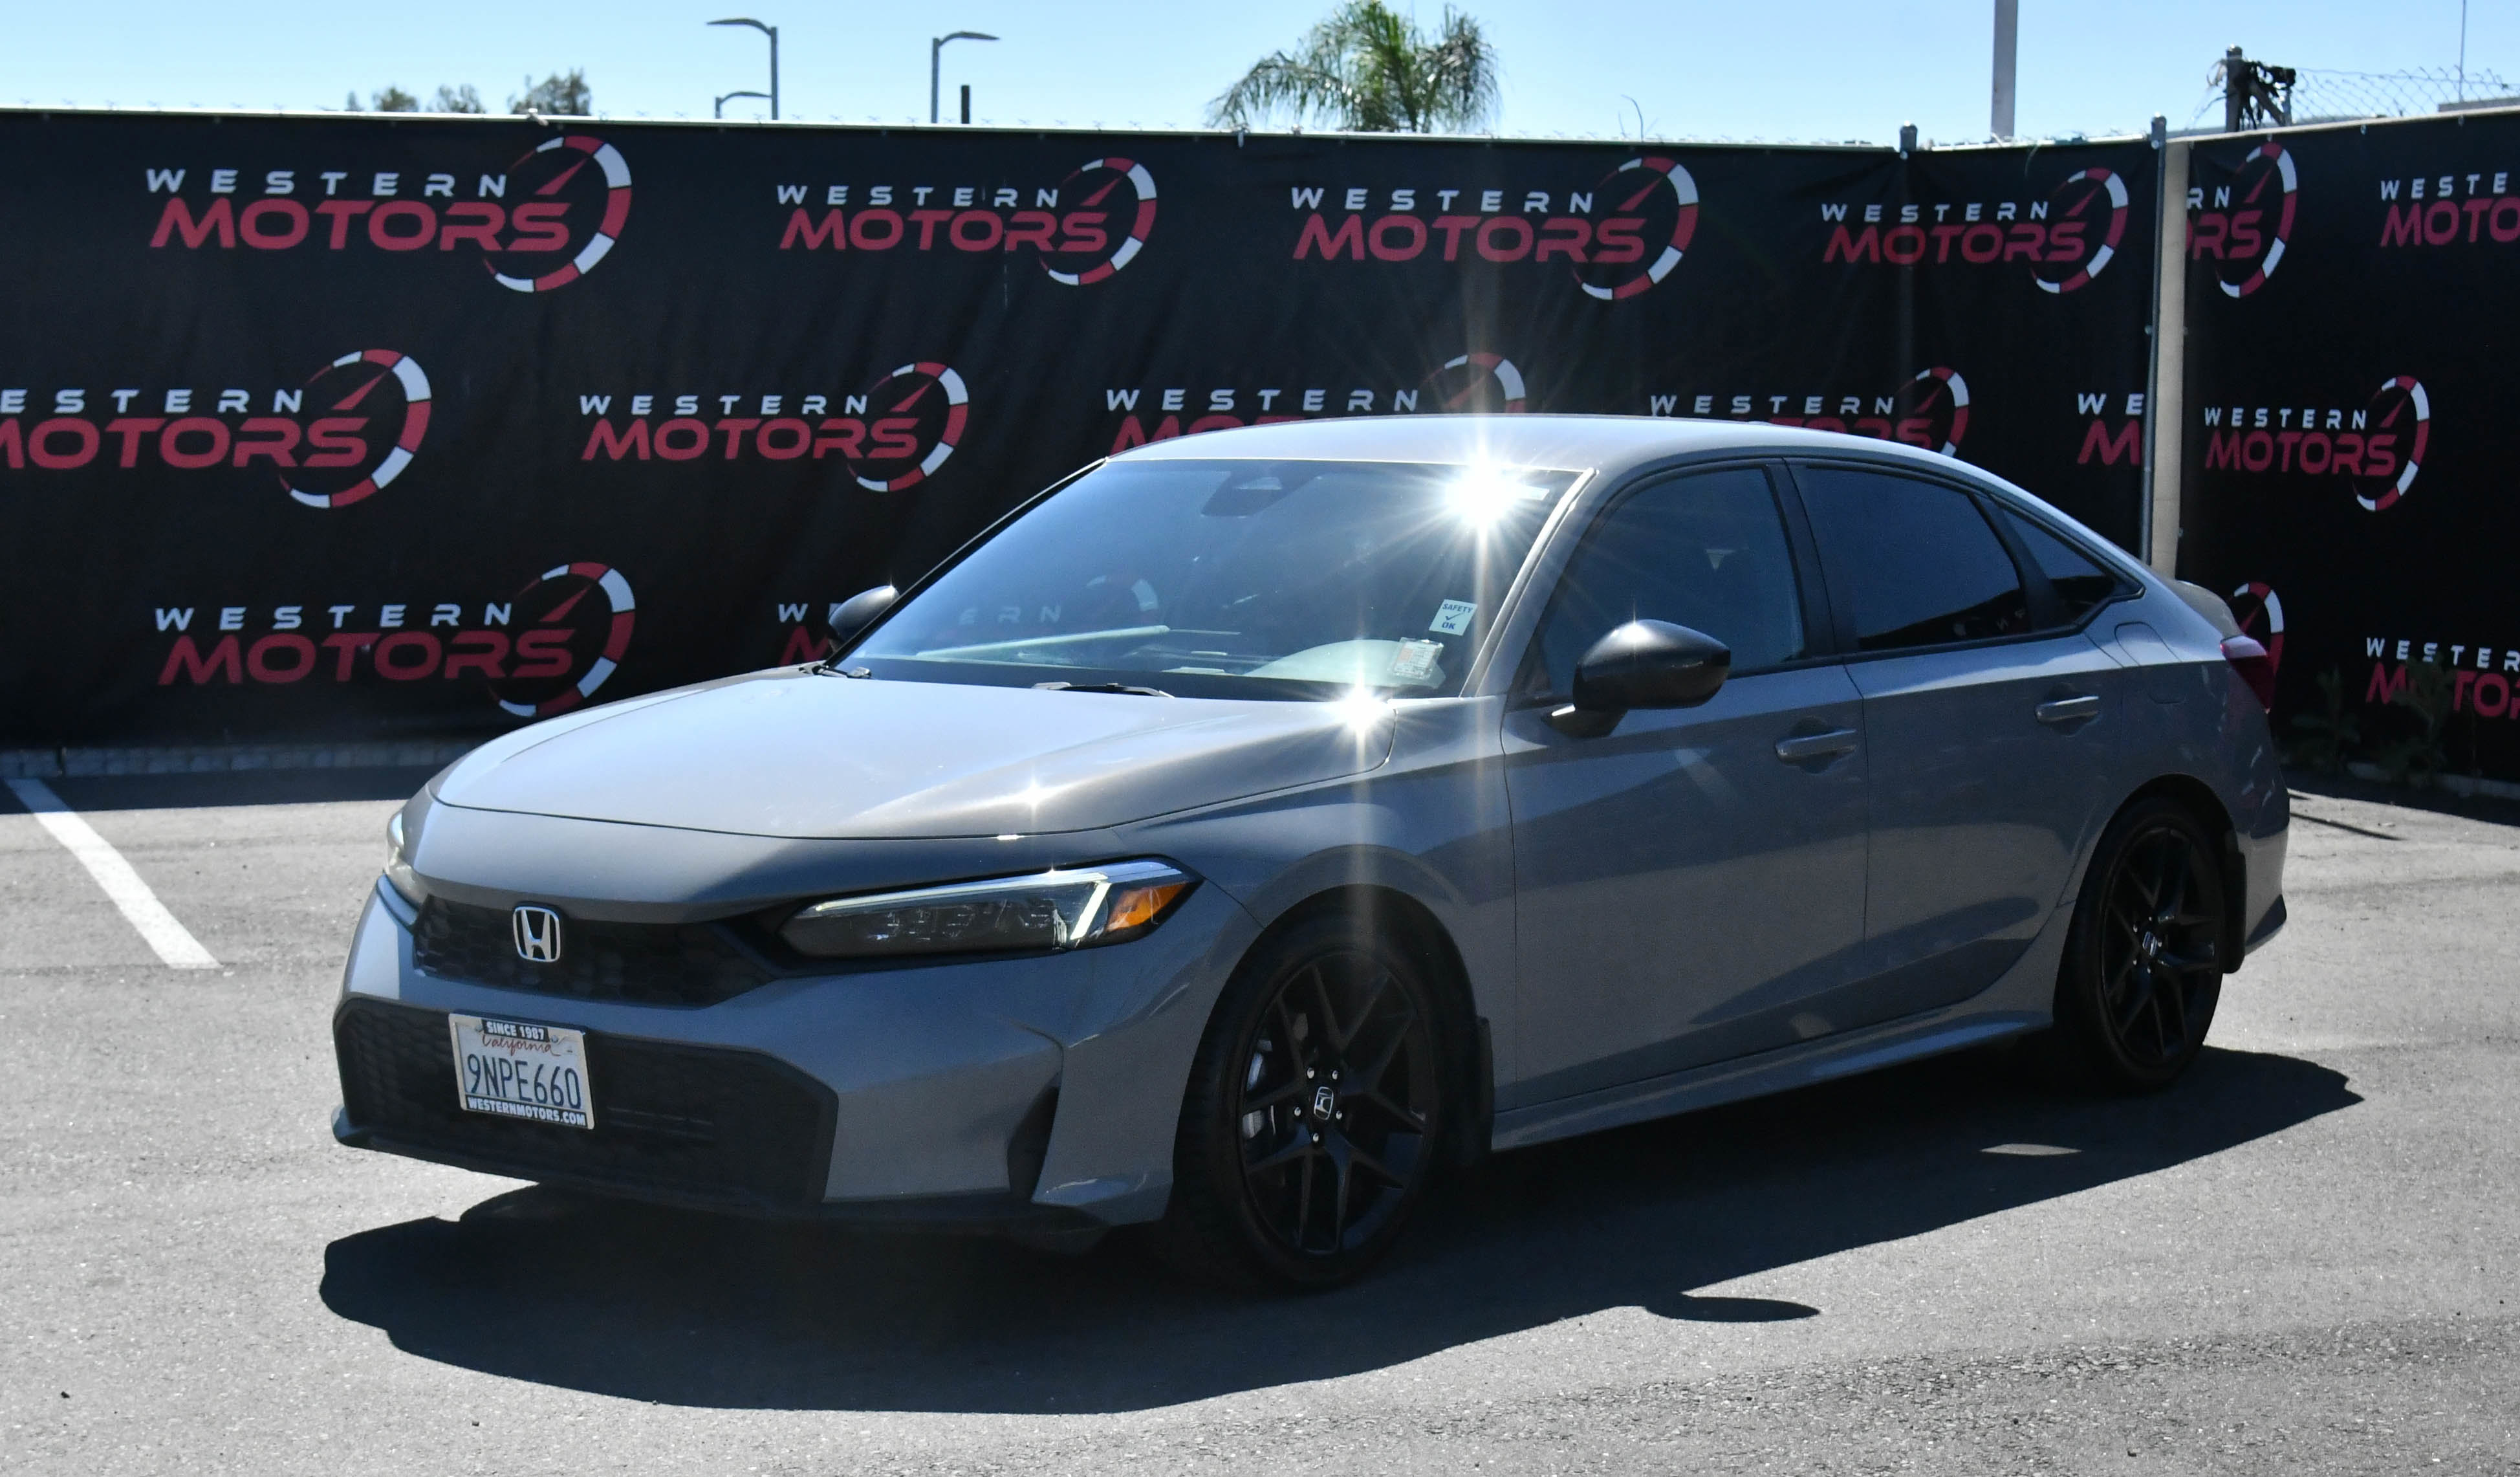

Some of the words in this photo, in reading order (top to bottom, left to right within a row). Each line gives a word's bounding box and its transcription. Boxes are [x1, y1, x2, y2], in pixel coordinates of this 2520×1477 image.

[146, 169, 506, 197] WESTERN
[777, 185, 1058, 208] WESTERN
[2380, 171, 2508, 201] WESTE
[1291, 187, 1592, 213] WESTERN
[1821, 201, 2048, 221] WESTERN
[149, 197, 571, 252] MOTORS
[779, 209, 1109, 252] MOTORS
[2380, 196, 2520, 247] MOTO
[1294, 213, 1647, 263] MOTORS
[1823, 223, 2087, 263] MOTORS
[580, 395, 867, 415] WESTERN
[1105, 389, 1418, 412] WESTERN
[1650, 395, 1894, 416] WESTERN
[2204, 408, 2367, 430] WESTERN
[582, 418, 919, 461] MOTORS
[2206, 430, 2397, 477] MOTORS
[155, 603, 512, 631] WESTERN
[1442, 603, 1473, 613] SAFETY
[1442, 622, 1456, 630] OK
[158, 628, 576, 686] MOTORS
[2365, 662, 2520, 720] MTO
[486, 1022, 517, 1036] SINCE
[519, 1026, 545, 1040] 1987
[467, 1053, 581, 1109] 9NPE660
[467, 1096, 586, 1127] WESTERNMOTORS.COM
